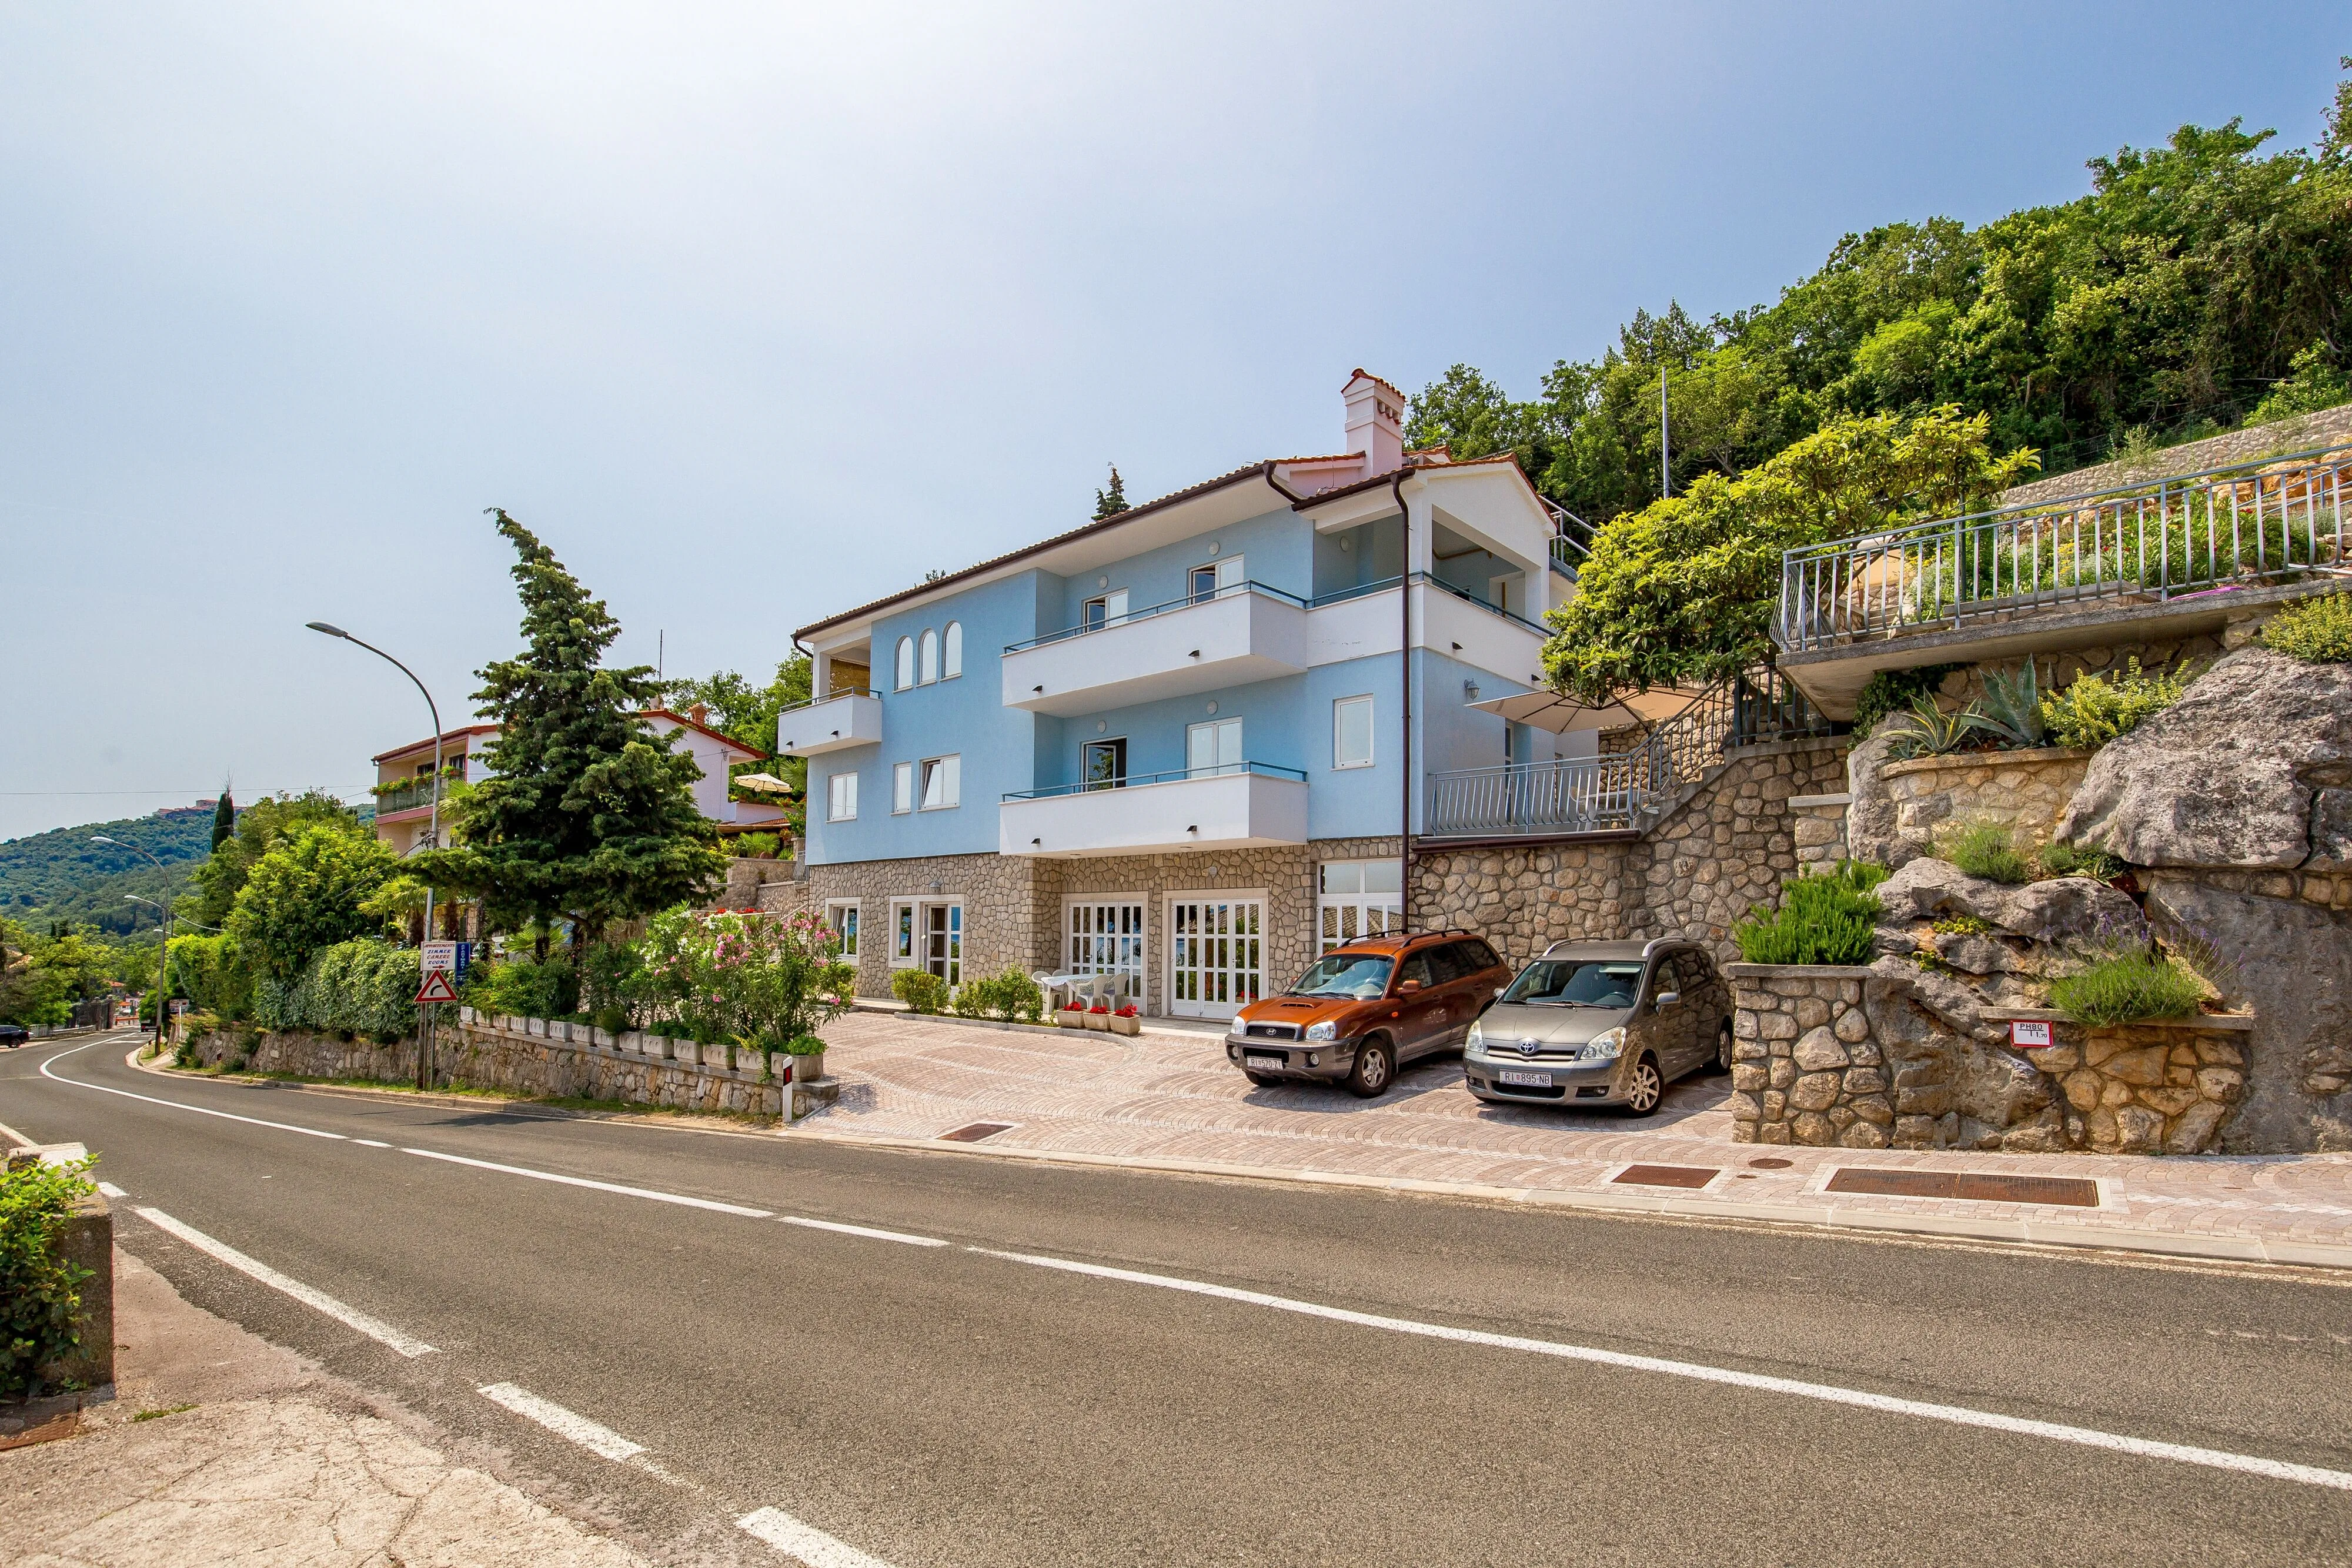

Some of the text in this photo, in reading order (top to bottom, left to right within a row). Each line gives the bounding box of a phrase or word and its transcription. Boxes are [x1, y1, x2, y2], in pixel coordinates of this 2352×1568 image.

[1251, 1058, 1258, 1066] RI
[1505, 1072, 1514, 1081] RI
[1521, 1074, 1550, 1085] 895-NB
